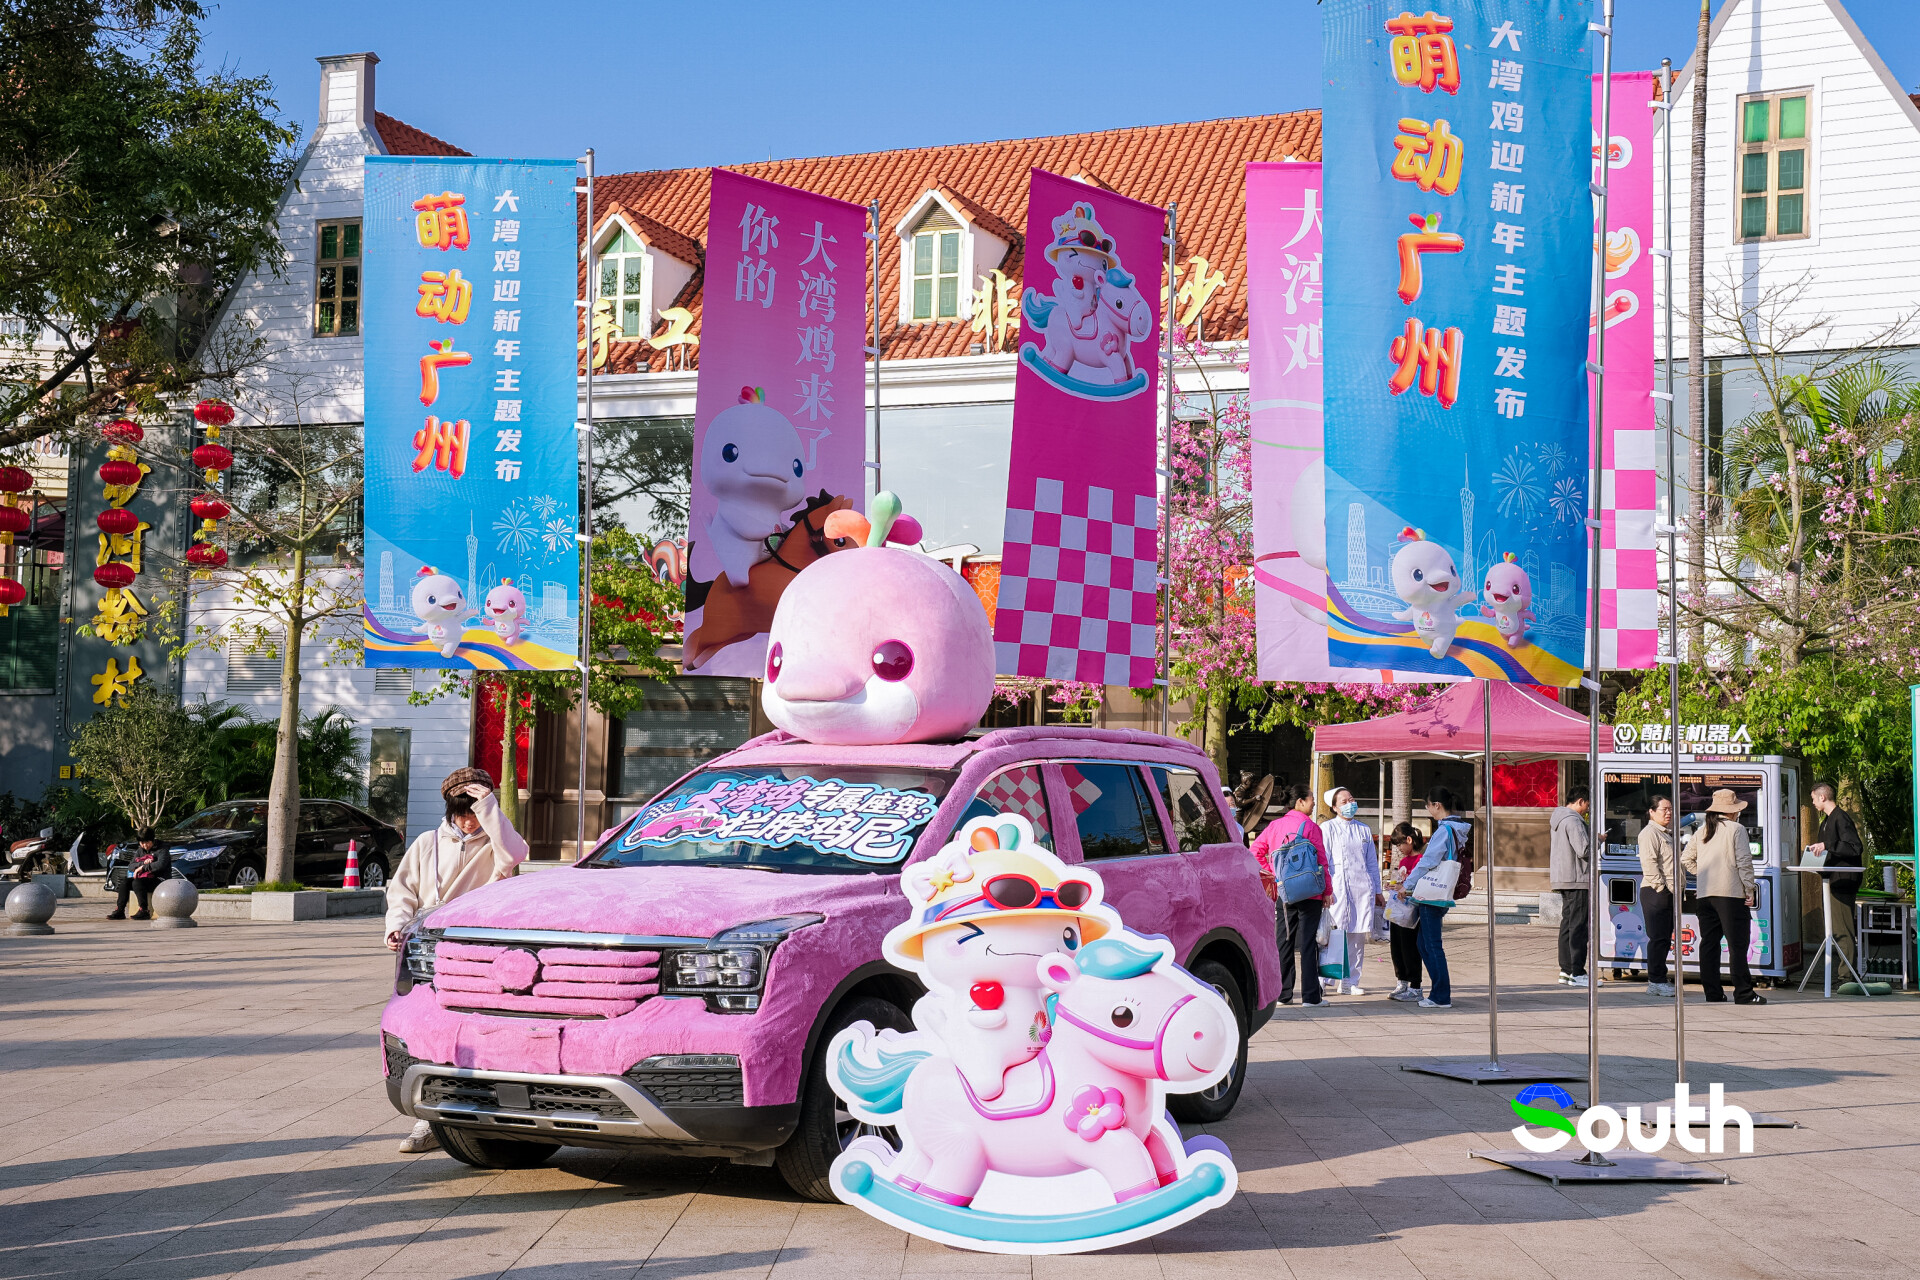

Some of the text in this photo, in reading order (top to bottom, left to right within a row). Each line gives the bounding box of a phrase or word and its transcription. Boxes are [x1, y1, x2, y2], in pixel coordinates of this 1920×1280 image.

[412, 192, 472, 480] 萌动广州
[492, 188, 522, 482] 大湾鸡迎新年主题发布
[735, 203, 780, 309] 你的
[793, 221, 839, 471] 大湾鸡来了
[1387, 12, 1465, 410] 萌动广州
[1487, 20, 1527, 419] 大湾鸡迎新年主题发布
[1691, 743, 1753, 755] ROBOT
